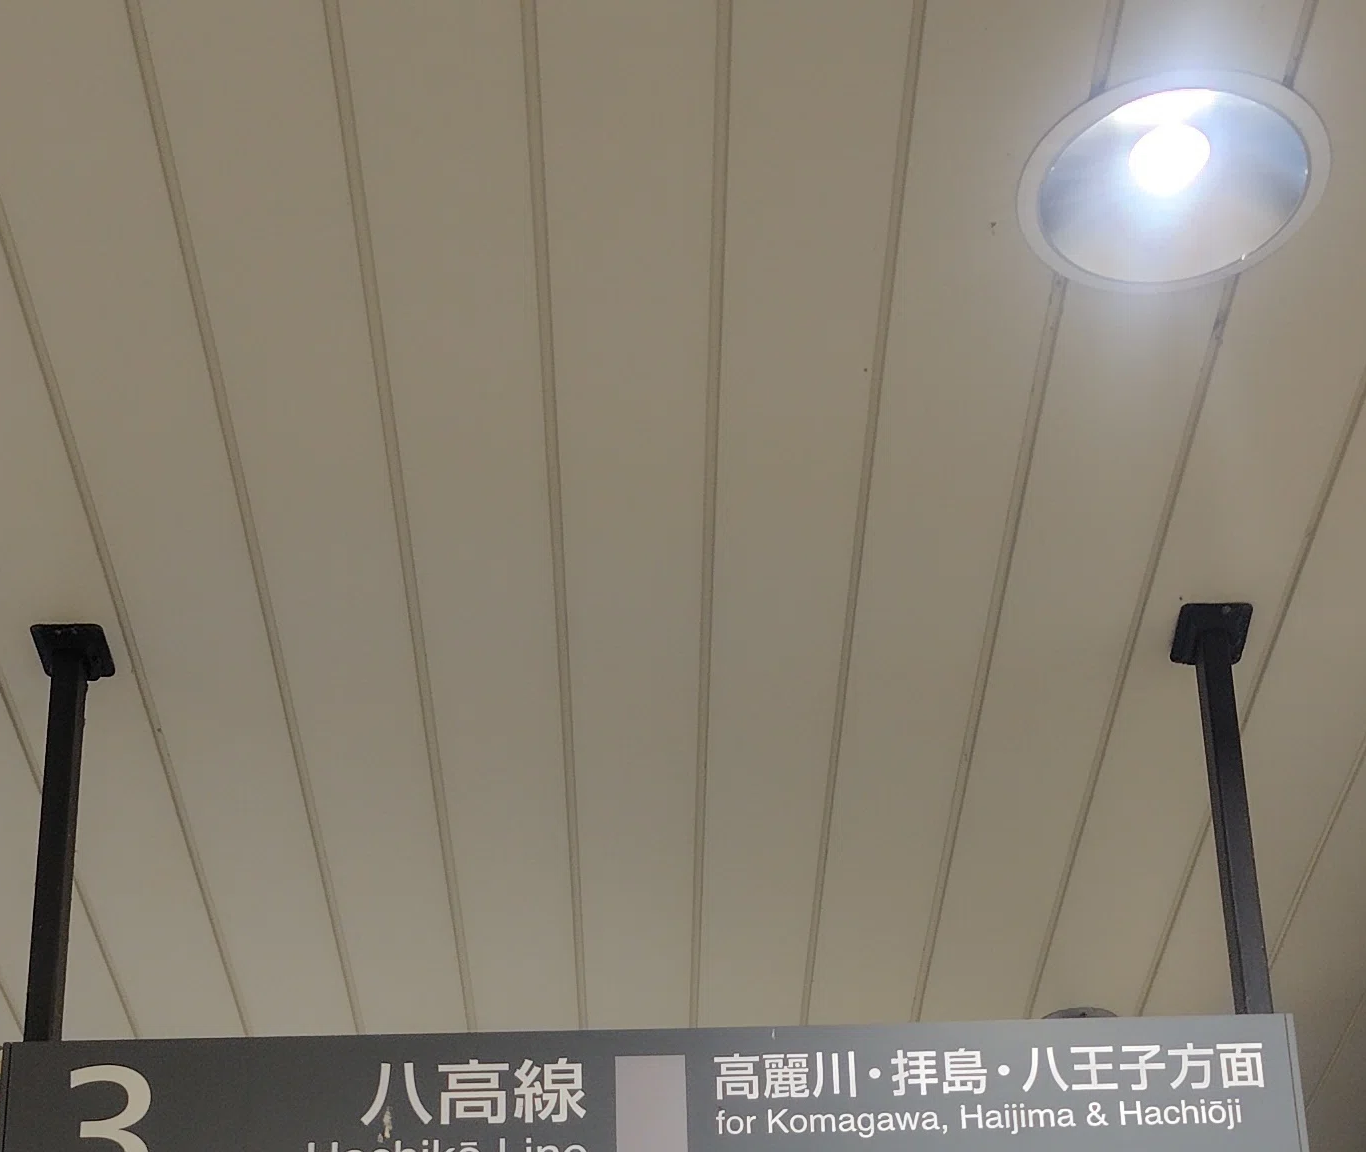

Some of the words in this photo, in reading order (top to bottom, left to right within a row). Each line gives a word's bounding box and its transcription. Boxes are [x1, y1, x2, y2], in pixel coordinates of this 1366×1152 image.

[360, 1056, 586, 1127] 八高線
[713, 1042, 1266, 1100] 高麗川・拝島・八王子方面
[716, 1107, 756, 1136] for
[767, 1106, 949, 1139] Komagawa,
[959, 1102, 1076, 1135] Haijima
[1085, 1103, 1110, 1127] &
[1119, 1097, 1244, 1130] Hachiōji
